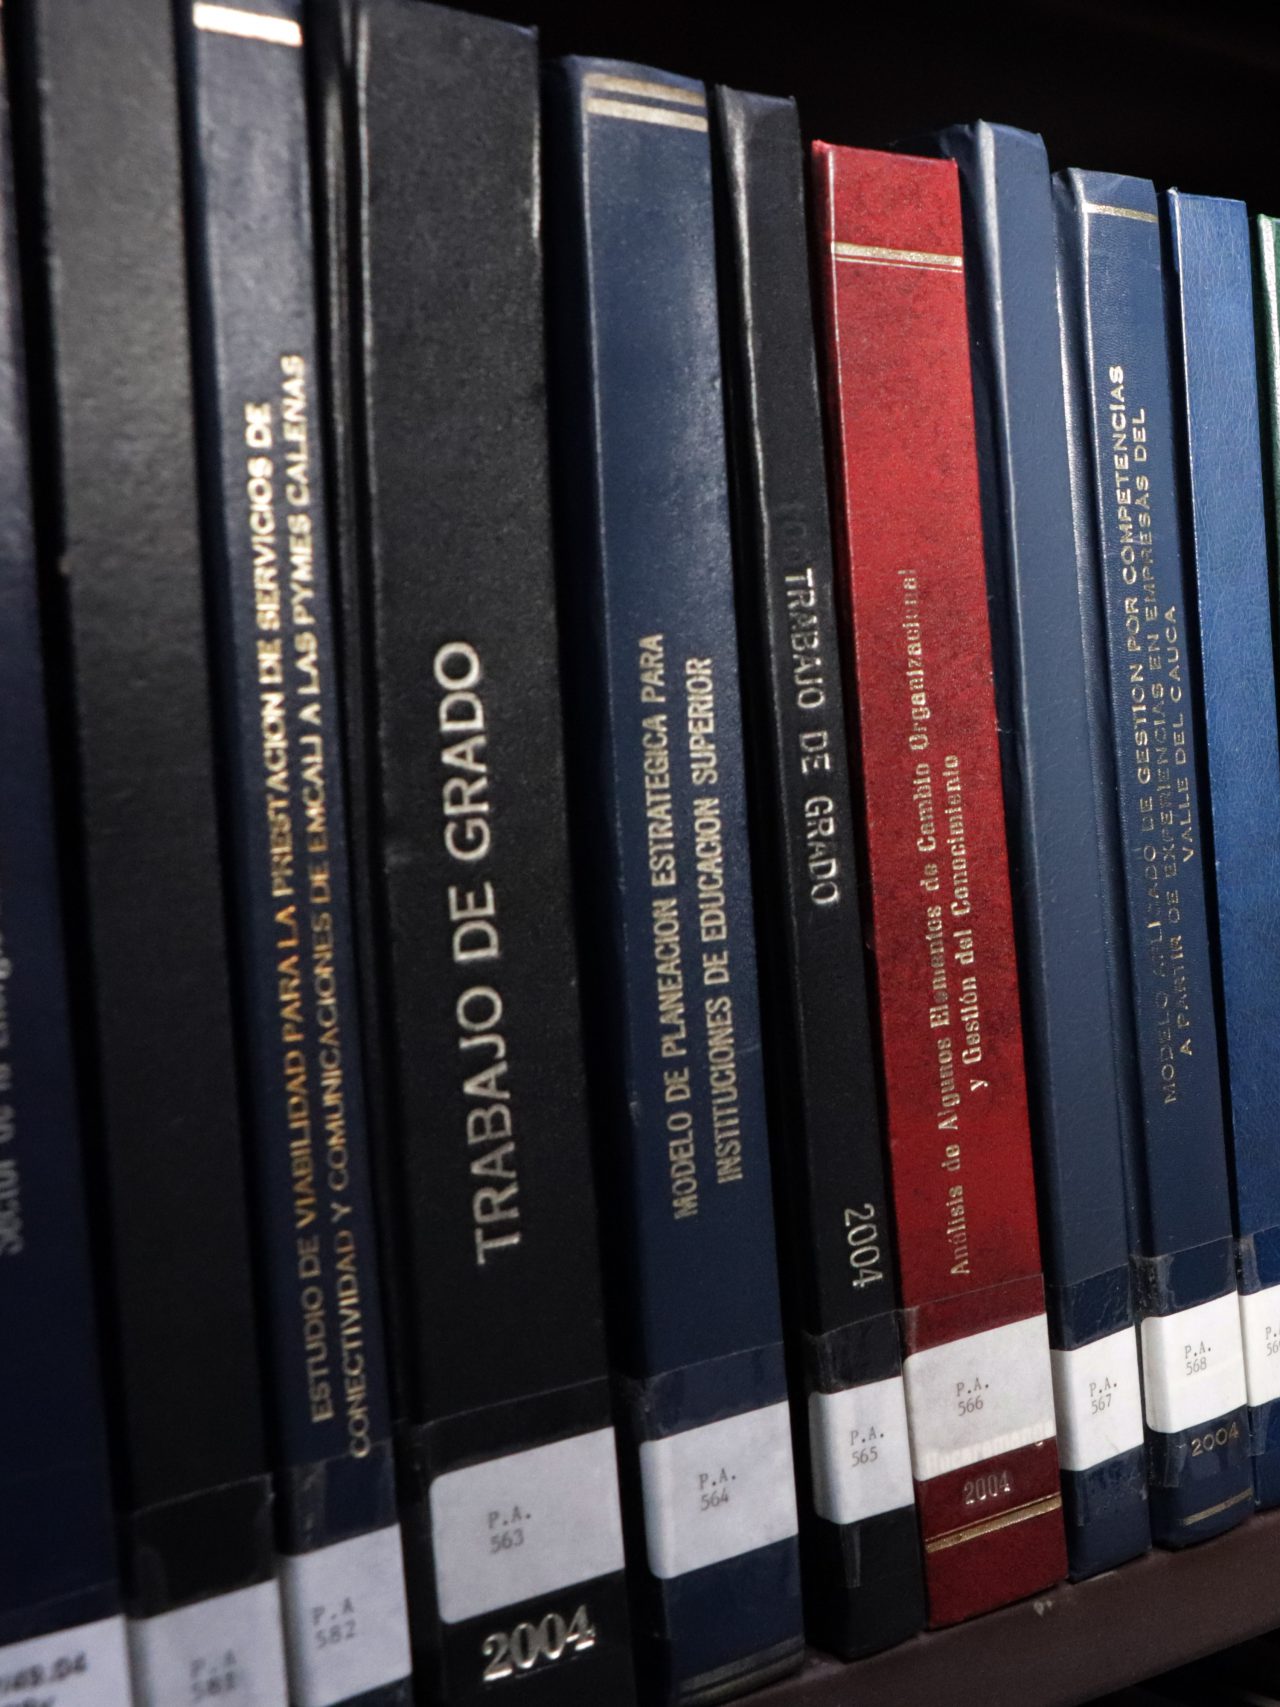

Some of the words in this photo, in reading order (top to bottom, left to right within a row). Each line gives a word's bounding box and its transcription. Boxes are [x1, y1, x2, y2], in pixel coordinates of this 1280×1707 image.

[247, 407, 271, 447] DE
[1131, 408, 1148, 461] DEL
[1109, 367, 1137, 584] COMPETENCIAS
[250, 459, 278, 628] SERVICIOS
[290, 516, 313, 625] PYMES
[1135, 476, 1158, 620] EMPRESAS
[785, 568, 826, 710] TRABAJO
[1124, 597, 1142, 651] POR
[1147, 633, 1161, 669] EN
[1164, 605, 1182, 702] CAUCA
[258, 641, 281, 684] DE
[297, 633, 319, 695] LAS
[640, 635, 665, 703] PARA
[298, 703, 321, 725] A
[686, 659, 717, 784] SUPERIOR
[1129, 664, 1151, 784] GESTION
[1171, 712, 1187, 765] DEL
[434, 641, 490, 862] GRADO
[799, 730, 831, 774] DE
[1151, 683, 1177, 877] EXPERIENCIAS
[263, 693, 292, 896] PRESTACION
[301, 735, 326, 852] EMCALI
[644, 715, 675, 886] ESTRATEGICA
[911, 763, 937, 851] Cambio
[1139, 797, 1154, 831] DE
[1176, 776, 1194, 861] VALLE
[804, 796, 841, 905] GRADO
[942, 755, 970, 915] Conocimiento
[309, 864, 331, 904] DE
[695, 799, 726, 941] EDUCACION
[919, 863, 939, 890] de
[274, 904, 299, 949] LA
[448, 881, 500, 963] DE
[1165, 889, 1180, 922] DE
[654, 900, 686, 1057] PLANEACION
[702, 952, 729, 985] DE
[924, 905, 950, 1027] Elementos
[952, 929, 975, 964] del
[279, 955, 303, 1042] PARA
[1169, 935, 1190, 1028] PARTIR
[313, 914, 347, 1190] COMUNICACIONES
[959, 976, 982, 1064] Gestión
[1155, 991, 1178, 1104] MODELO
[1178, 1038, 1193, 1055] A
[664, 1069, 690, 1102] DE
[706, 998, 741, 1182] INSTITUCIONES
[937, 1037, 962, 1130] Algunos
[968, 1078, 989, 1090] y
[286, 1051, 315, 1227] VIABILIDAD
[456, 985, 521, 1266] TRABAJO
[941, 1144, 962, 1171] de
[668, 1112, 697, 1218] MODELO
[330, 1201, 353, 1223] Y
[944, 1184, 970, 1274] Análisis
[298, 1236, 321, 1278] DE
[844, 1203, 883, 1288] 2004
[302, 1287, 333, 1422] ESTUDIO
[337, 1231, 370, 1457] CONECTIVIDAD
[1185, 1341, 1211, 1360] P.A.
[1186, 1357, 1207, 1376] 568
[956, 1377, 989, 1397] P.A.
[958, 1395, 984, 1416] 566
[1089, 1377, 1117, 1397] P.A.
[1091, 1393, 1112, 1415] 567
[850, 1426, 884, 1446] P.A.
[851, 1446, 878, 1467] 565
[1191, 1422, 1239, 1457] 2004
[699, 1468, 736, 1490] P.A.
[701, 1489, 730, 1511] 564
[964, 1470, 1011, 1505] 2004
[488, 1506, 531, 1529] P.A.
[491, 1529, 525, 1554] 563
[314, 1620, 356, 1648] 582
[482, 1604, 597, 1681] 2004
